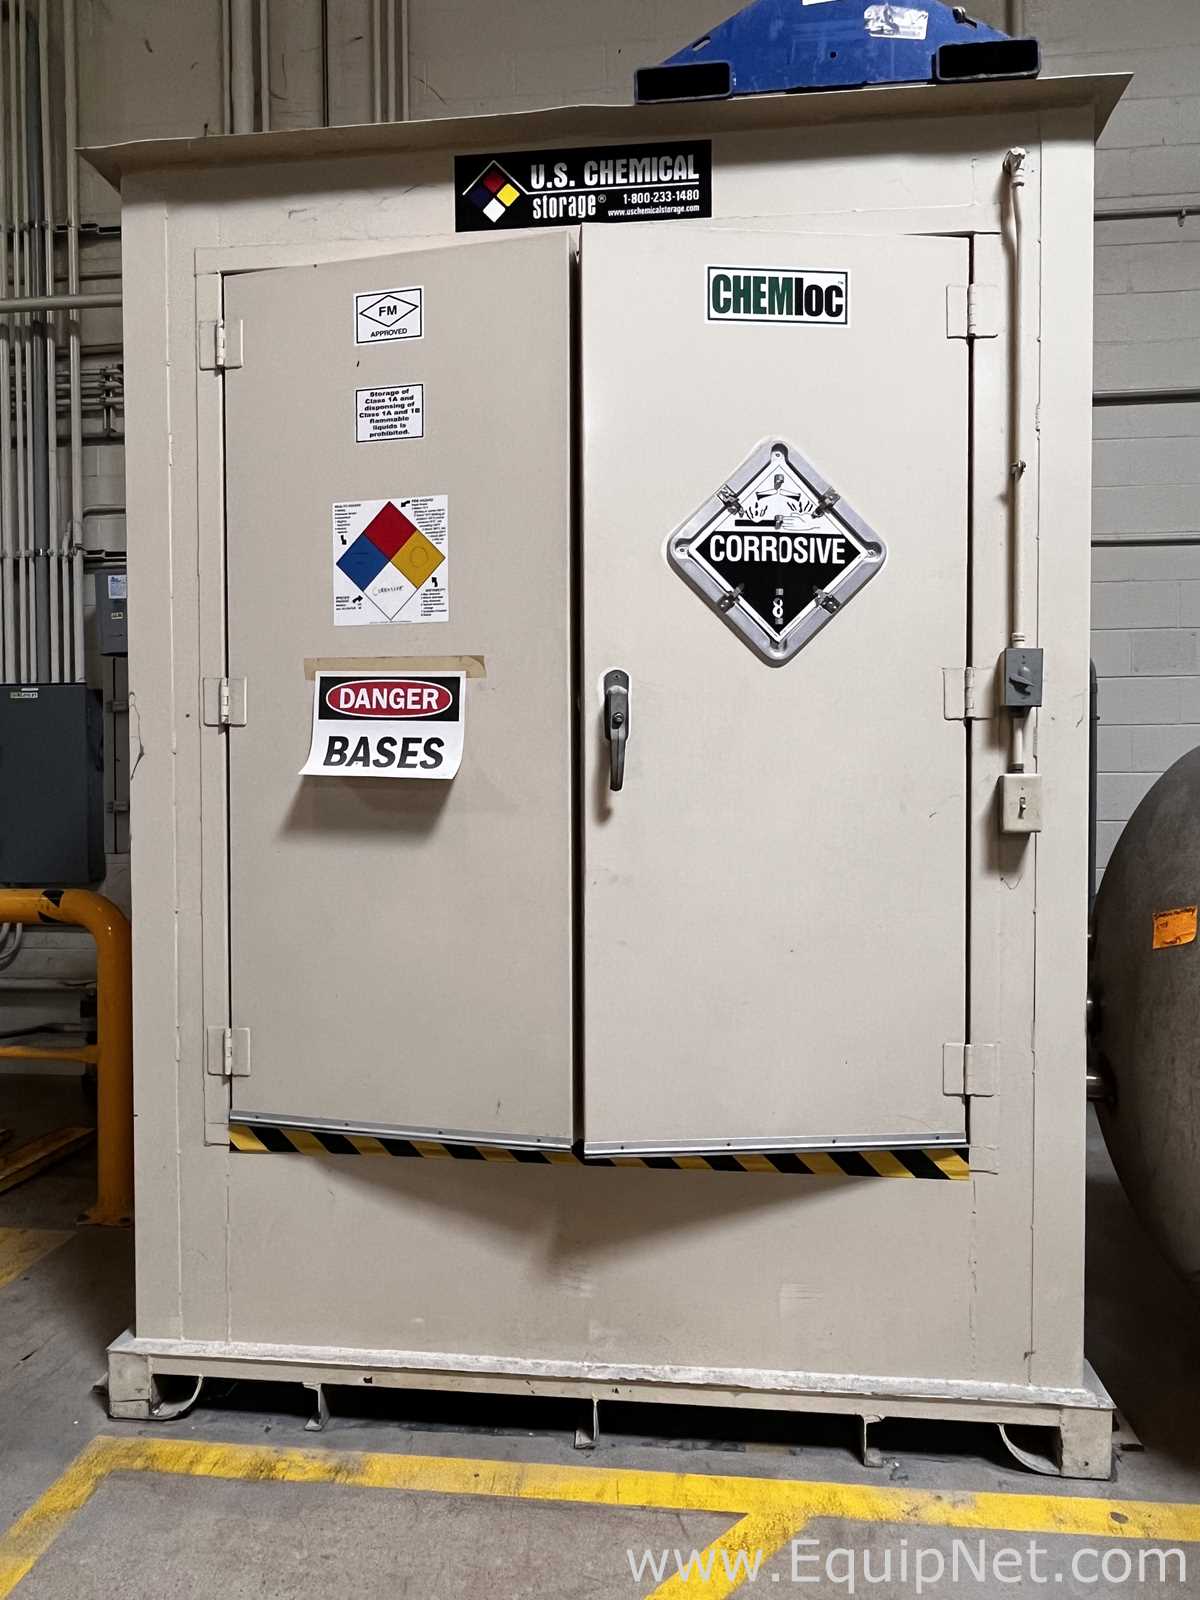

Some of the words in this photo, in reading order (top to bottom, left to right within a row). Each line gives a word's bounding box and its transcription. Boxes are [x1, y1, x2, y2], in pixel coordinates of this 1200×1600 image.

[530, 163, 576, 190] U.S.
[584, 154, 699, 186] CHEMICAL
[623, 189, 700, 205] 1-800-233-1480
[607, 204, 700, 217] www.uschemicalstorage.com
[378, 305, 397, 317] FM
[370, 327, 408, 338] APPROVED
[369, 390, 400, 398] Storage
[364, 402, 405, 411] dispensing
[369, 415, 410, 424] flammable
[372, 423, 398, 431] liquids
[709, 534, 846, 565] CORROSIVE
[772, 597, 784, 618] 8
[339, 687, 440, 710] DANGER
[323, 735, 445, 769] BASES
